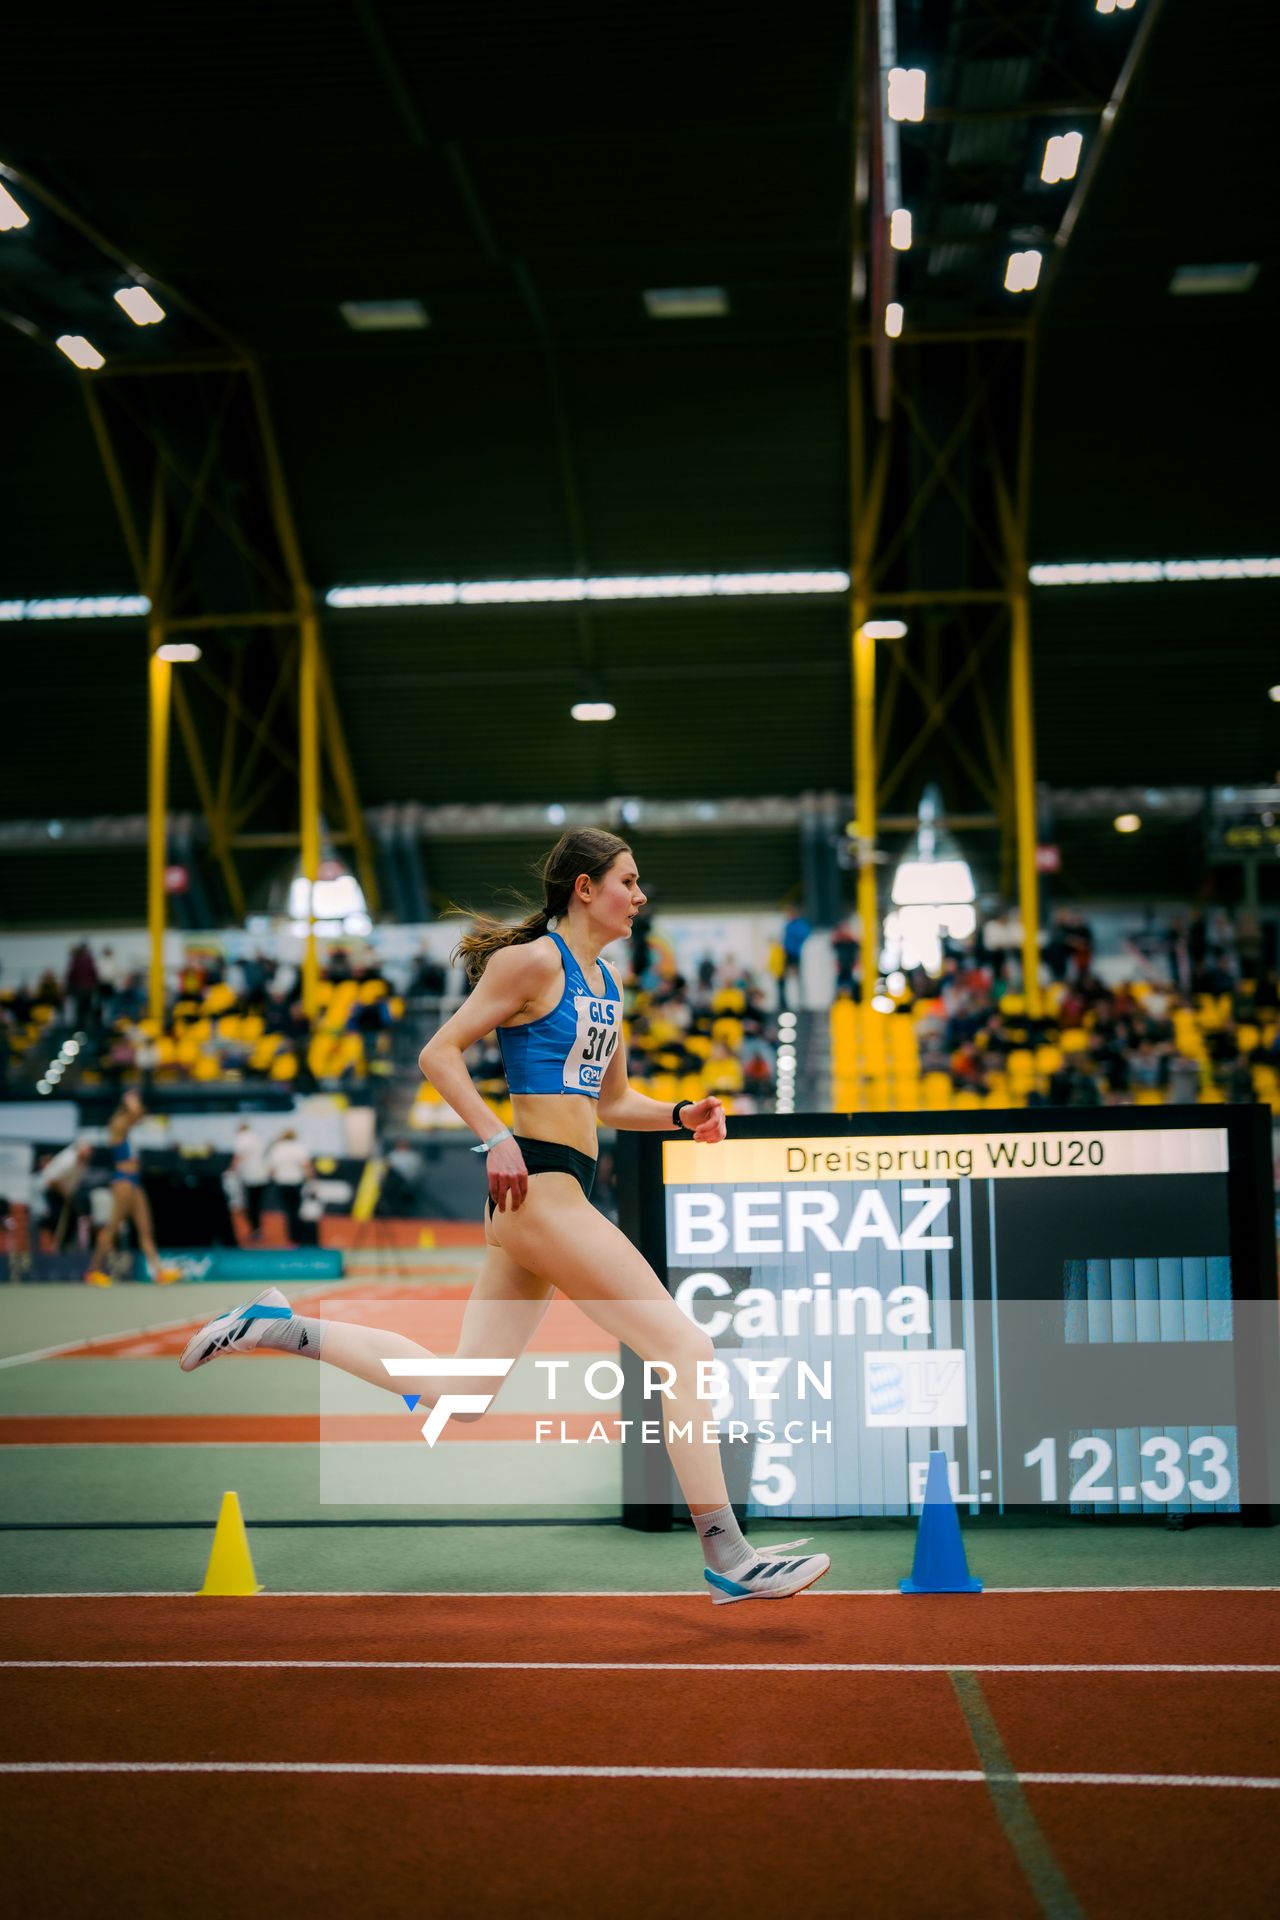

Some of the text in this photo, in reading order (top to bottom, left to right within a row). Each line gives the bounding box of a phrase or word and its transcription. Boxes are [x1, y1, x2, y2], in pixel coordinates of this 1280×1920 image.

[589, 1001, 615, 1025] GLS
[786, 1139, 1106, 1177] Dreisprung WJU20
[673, 1187, 954, 1256] BERAZ
[674, 1272, 933, 1340] Carina
[750, 1442, 797, 1506] 5
[1023, 1435, 1233, 1504] 12.33
